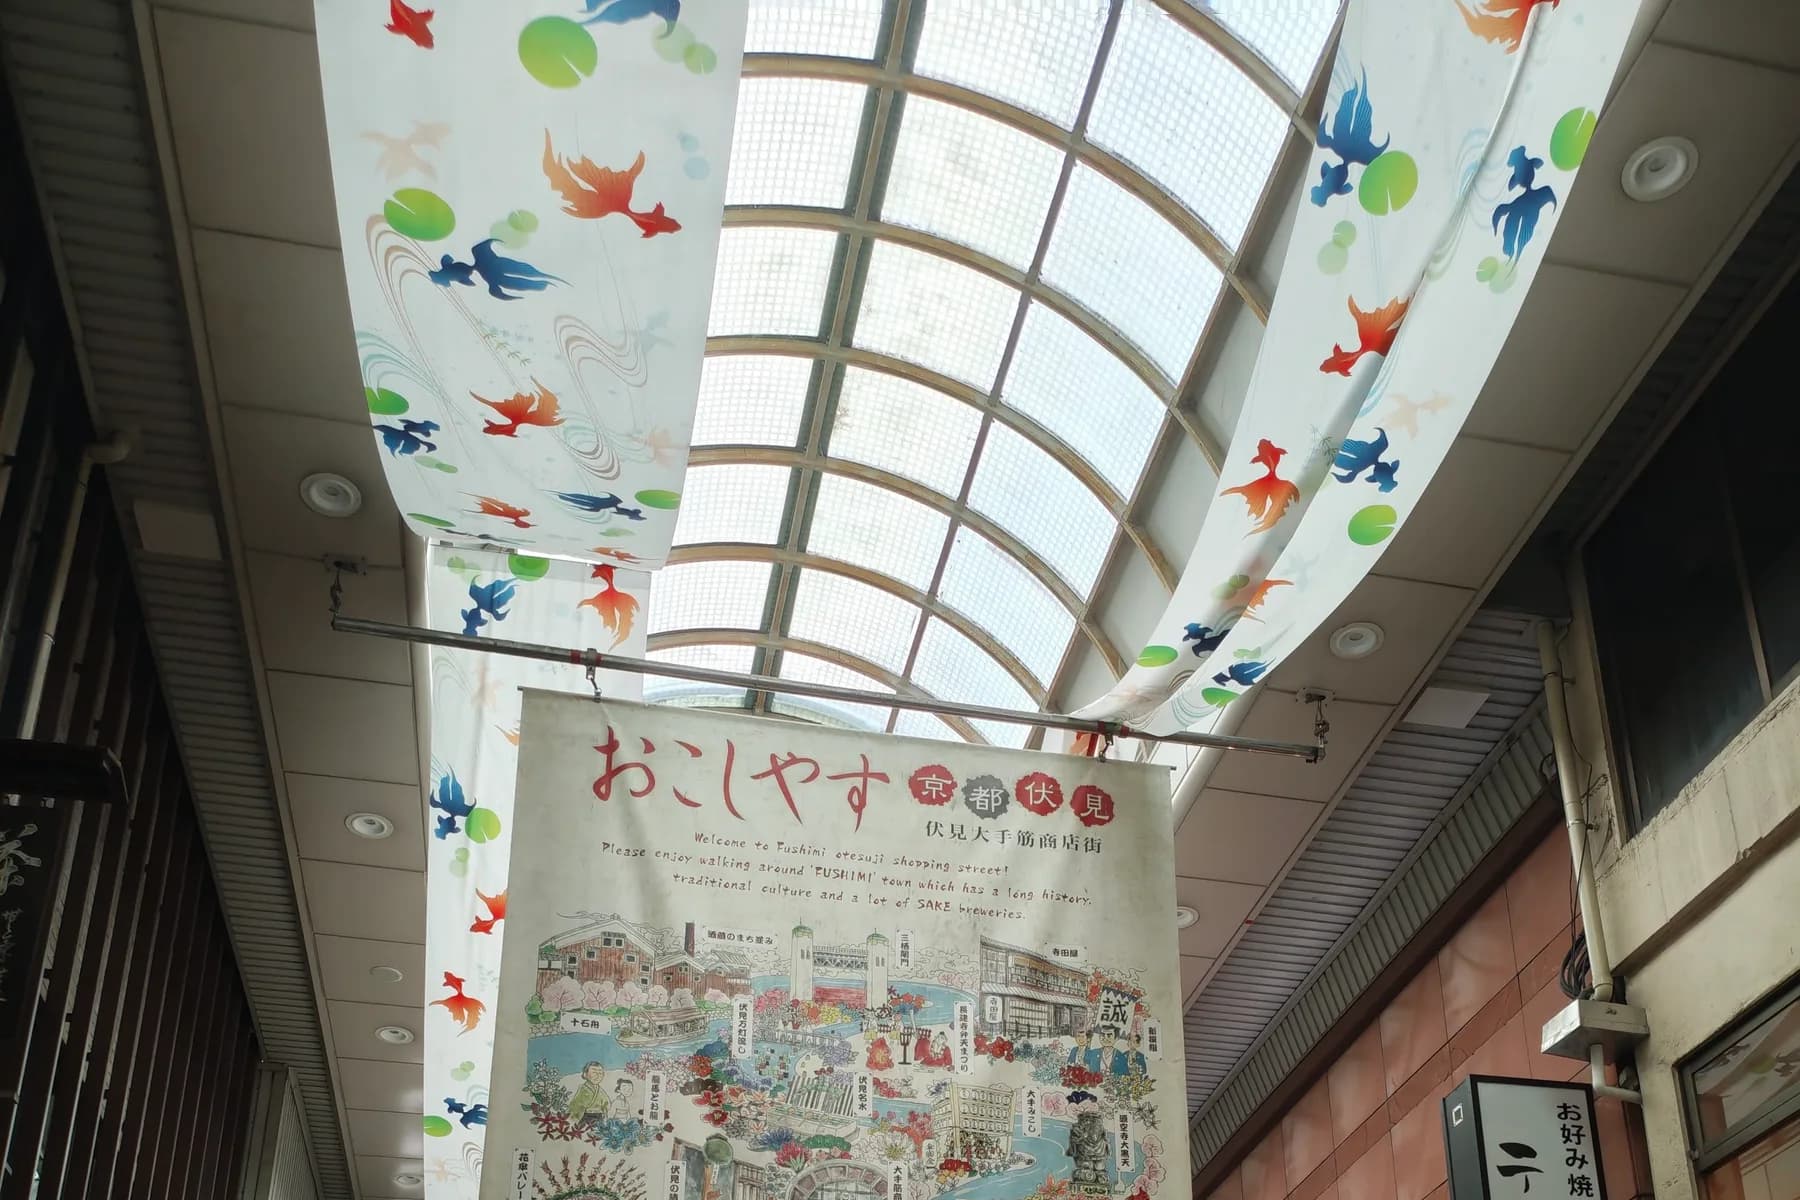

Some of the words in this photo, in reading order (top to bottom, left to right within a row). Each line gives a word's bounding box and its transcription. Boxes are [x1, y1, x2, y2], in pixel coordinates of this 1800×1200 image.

[593, 725, 890, 833] おこしやす
[915, 773, 1111, 821] 京都伏見
[694, 832, 747, 848] Welcome
[755, 840, 769, 851] to
[776, 841, 826, 857] Fushimi
[835, 850, 884, 865] otesuji
[892, 856, 951, 872] shopping
[957, 863, 1008, 877] street!
[926, 820, 1102, 854] 伏見大手筋商店街
[602, 841, 646, 857] Please
[654, 850, 693, 864] enjoy
[698, 855, 750, 871] walking
[758, 862, 804, 876] around
[882, 875, 912, 888] town
[918, 879, 955, 892] which
[962, 883, 985, 895] has
[991, 888, 999, 896] a
[1008, 887, 1034, 901] long
[1042, 890, 1092, 905] history.
[672, 873, 751, 891] traditional
[761, 883, 812, 899] culture
[820, 890, 843, 902] and
[851, 895, 859, 903] a
[868, 893, 887, 905] lot
[895, 897, 909, 908] of
[917, 897, 951, 912] SAKE
[959, 903, 1026, 919] breweries.
[570, 1016, 601, 1030] 十石舟
[1100, 998, 1129, 1027] 誠
[857, 1075, 868, 1112] 伏見名水
[1025, 1089, 1037, 1133] 大手みこし
